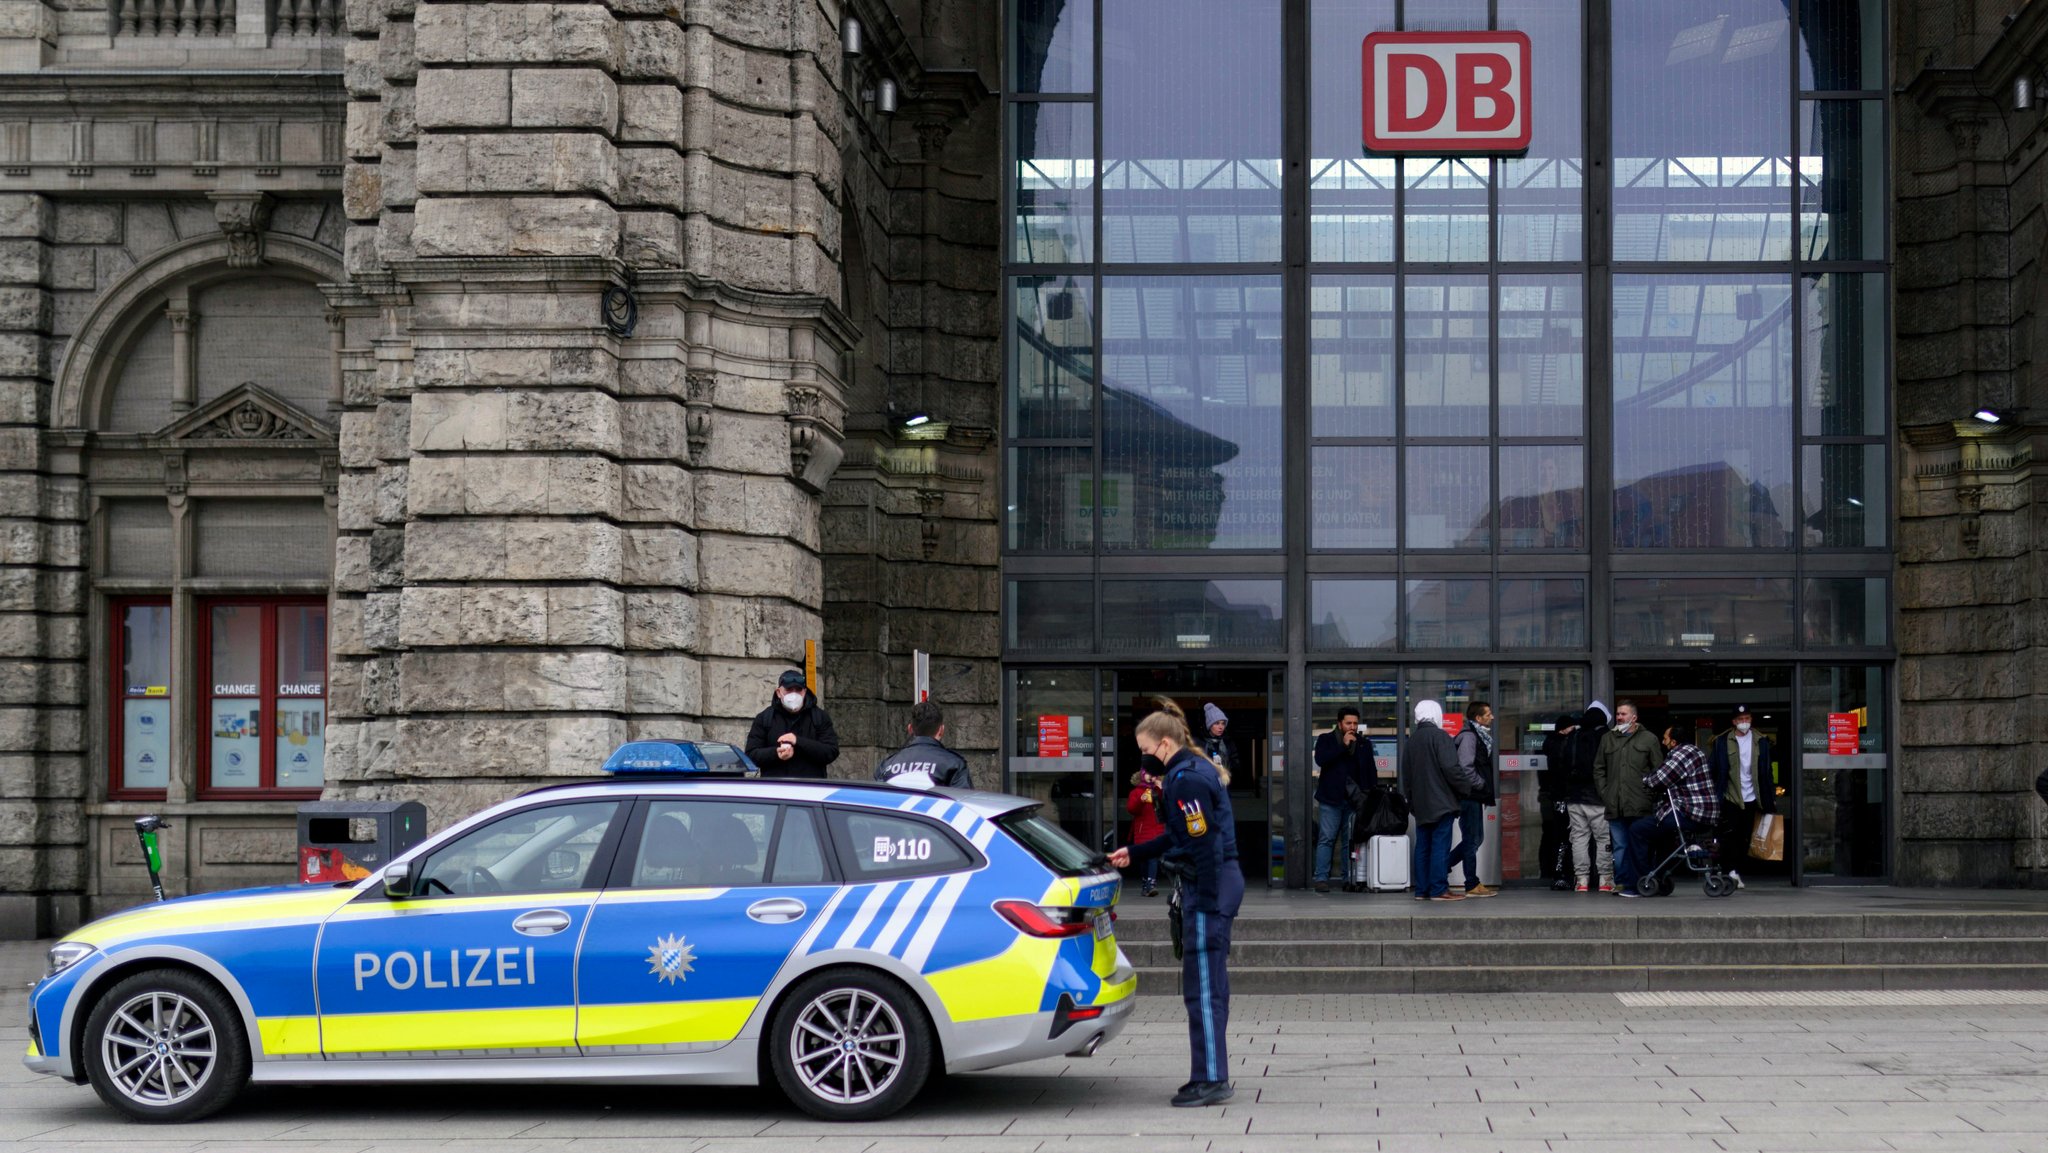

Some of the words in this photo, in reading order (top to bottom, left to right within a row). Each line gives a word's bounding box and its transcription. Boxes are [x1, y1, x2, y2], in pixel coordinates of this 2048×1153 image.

[1387, 53, 1516, 132] DB
[1162, 467, 1194, 477] MEHR
[1199, 467, 1241, 477] ERFOLG
[1162, 490, 1183, 501] MIT
[1187, 490, 1219, 501] IHRER
[1327, 490, 1351, 500] UND
[1162, 512, 1185, 524] DEN
[1189, 512, 1247, 524] DIGITALEN
[1314, 512, 1339, 523] VON
[215, 684, 256, 694] CHANGE
[280, 684, 320, 694] CHANGE
[884, 761, 937, 776] POLIZEI
[896, 839, 931, 860] 110
[1089, 886, 1110, 902] POLIZEI
[354, 947, 536, 991] POLIZEI
